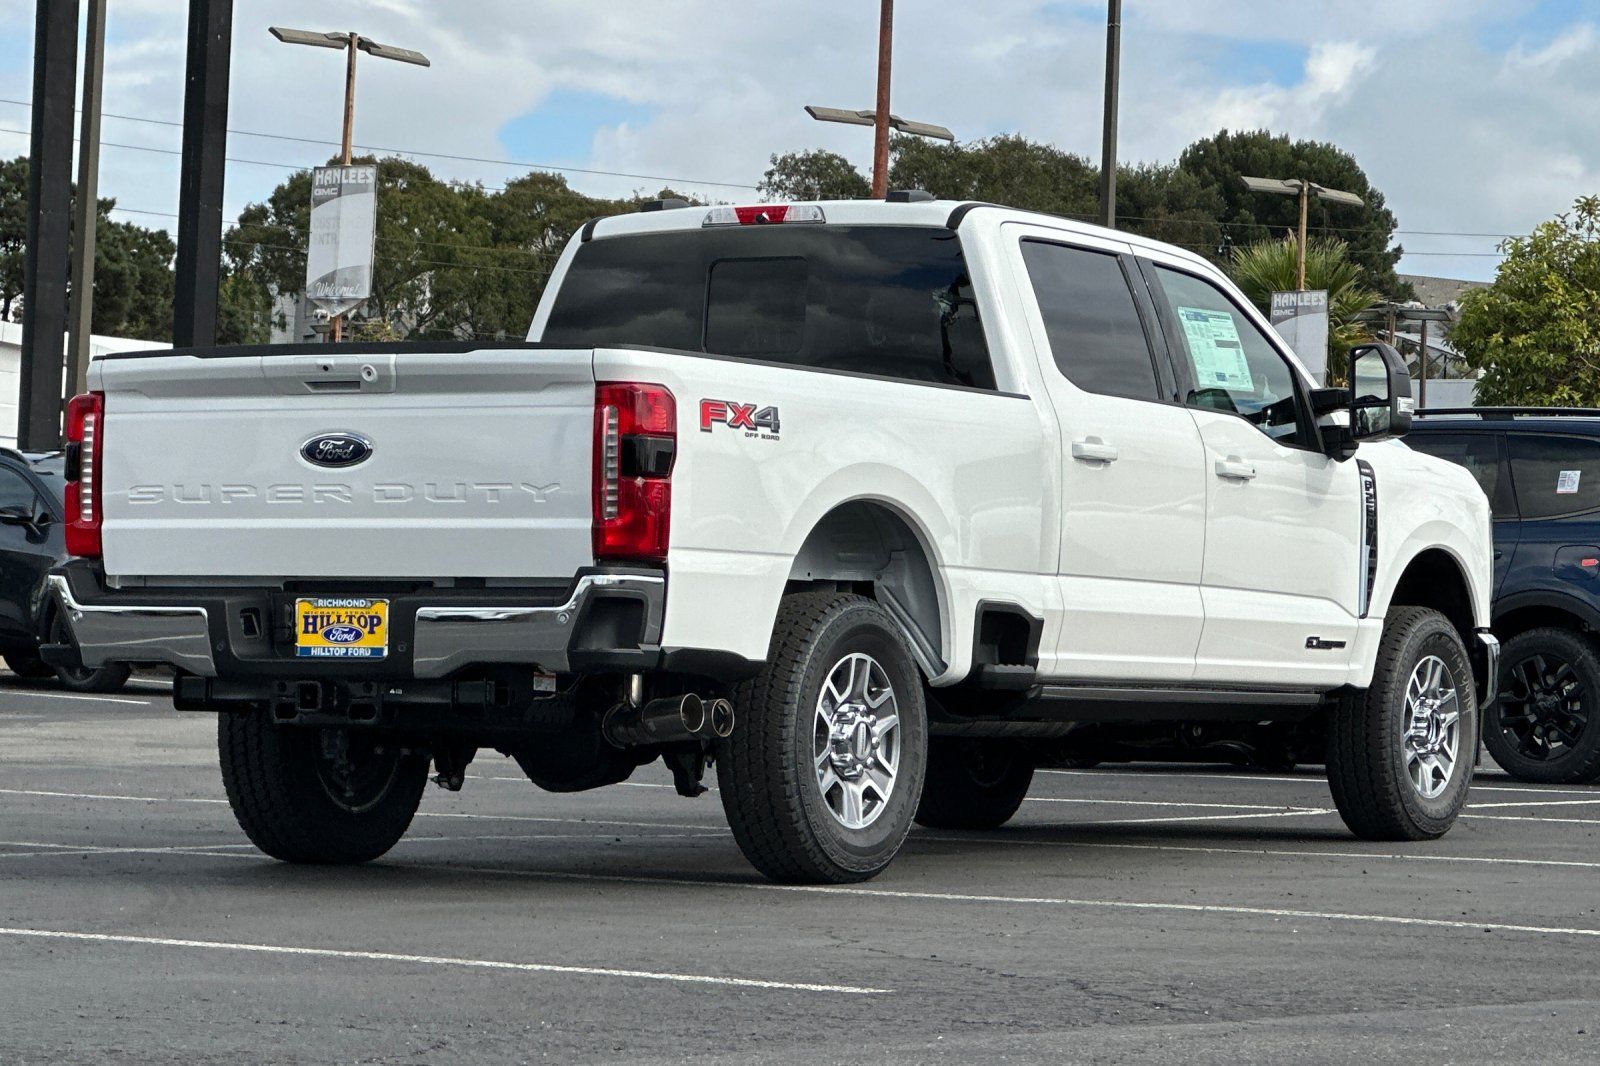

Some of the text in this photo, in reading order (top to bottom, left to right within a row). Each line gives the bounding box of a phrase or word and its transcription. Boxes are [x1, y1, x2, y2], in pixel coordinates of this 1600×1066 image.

[315, 167, 374, 185] HANLEES
[314, 187, 338, 196] GMC
[315, 281, 360, 296] Welcome!
[1273, 292, 1326, 307] HANLEES
[700, 398, 780, 433] FX4
[316, 440, 354, 460] Ford
[128, 482, 560, 504] SUPER DUTY
[318, 599, 366, 608] RICHMOND
[303, 614, 382, 634] HILLTOP
[330, 628, 356, 641] Ford
[311, 647, 372, 656] HILLTOP FORD
